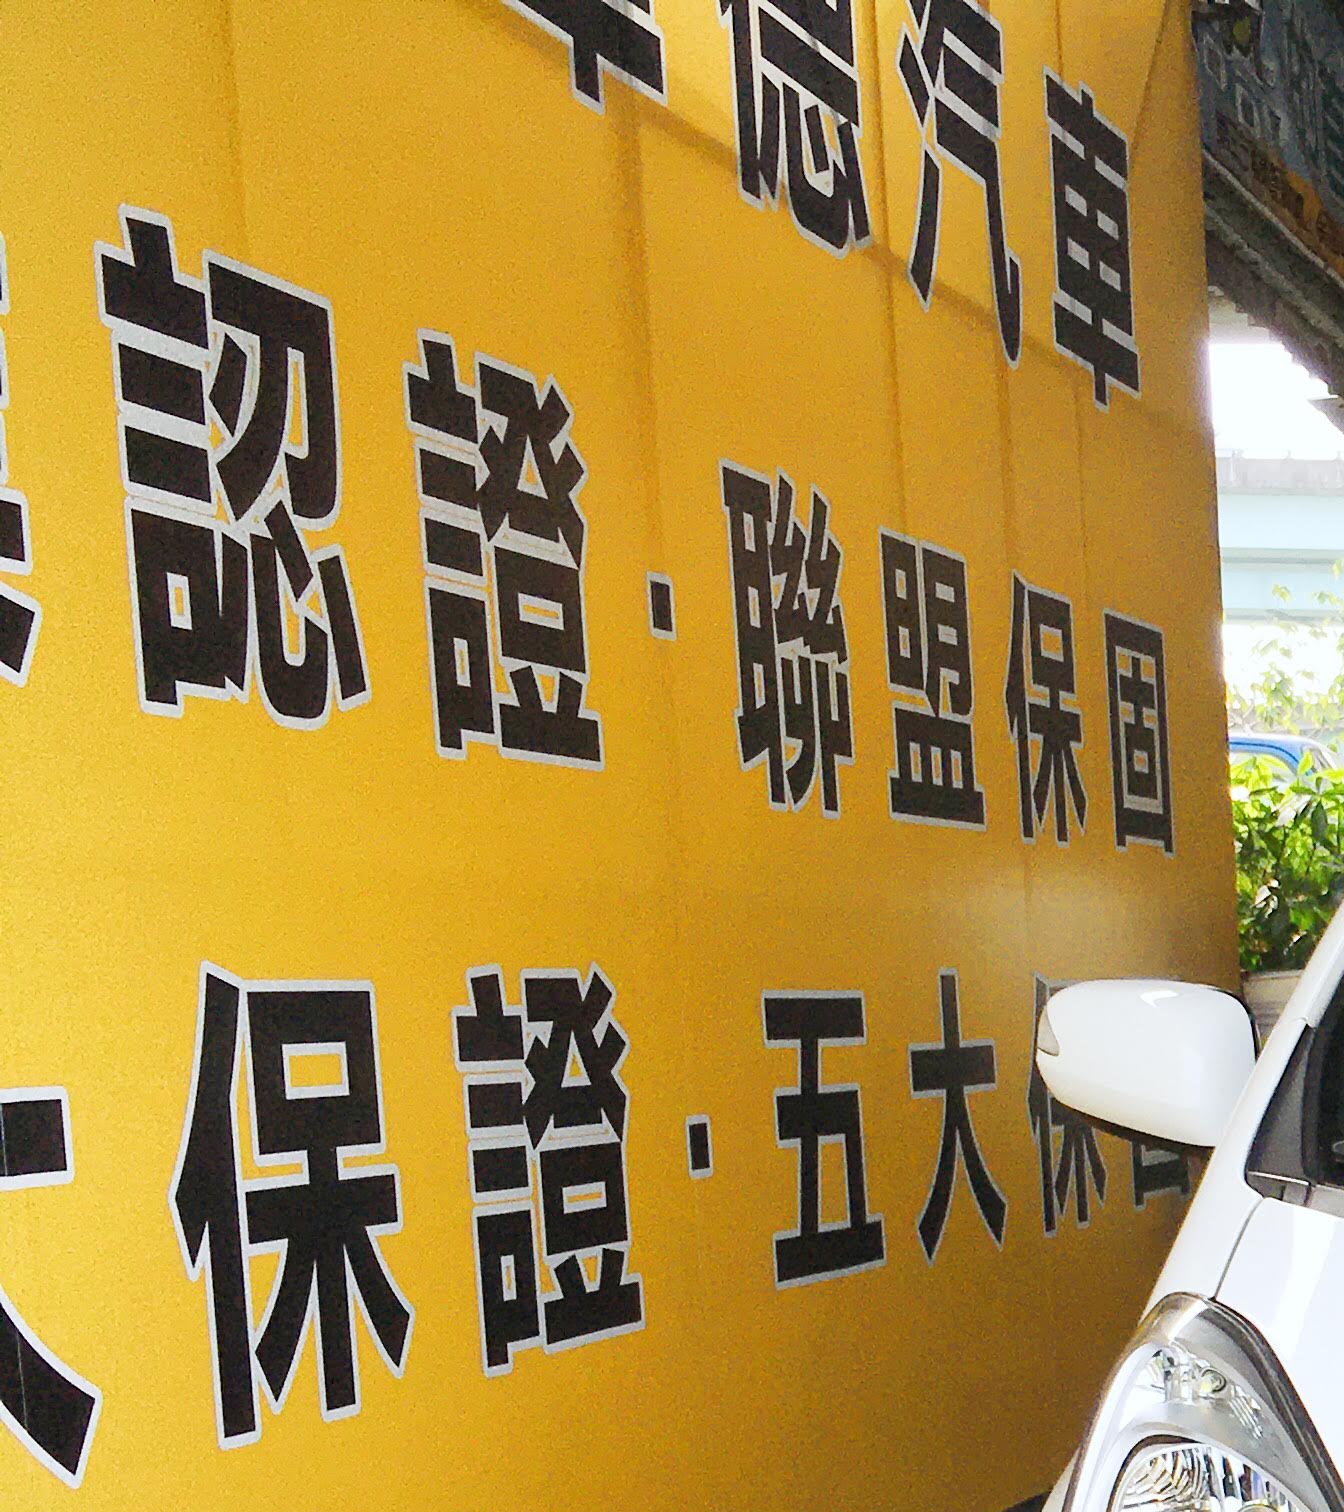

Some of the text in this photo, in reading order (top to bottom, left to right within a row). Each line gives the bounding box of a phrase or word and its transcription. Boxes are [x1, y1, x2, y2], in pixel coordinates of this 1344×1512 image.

[508, 0, 1142, 414] 德汽車
[0, 204, 1176, 858] 認證·聯盟保固
